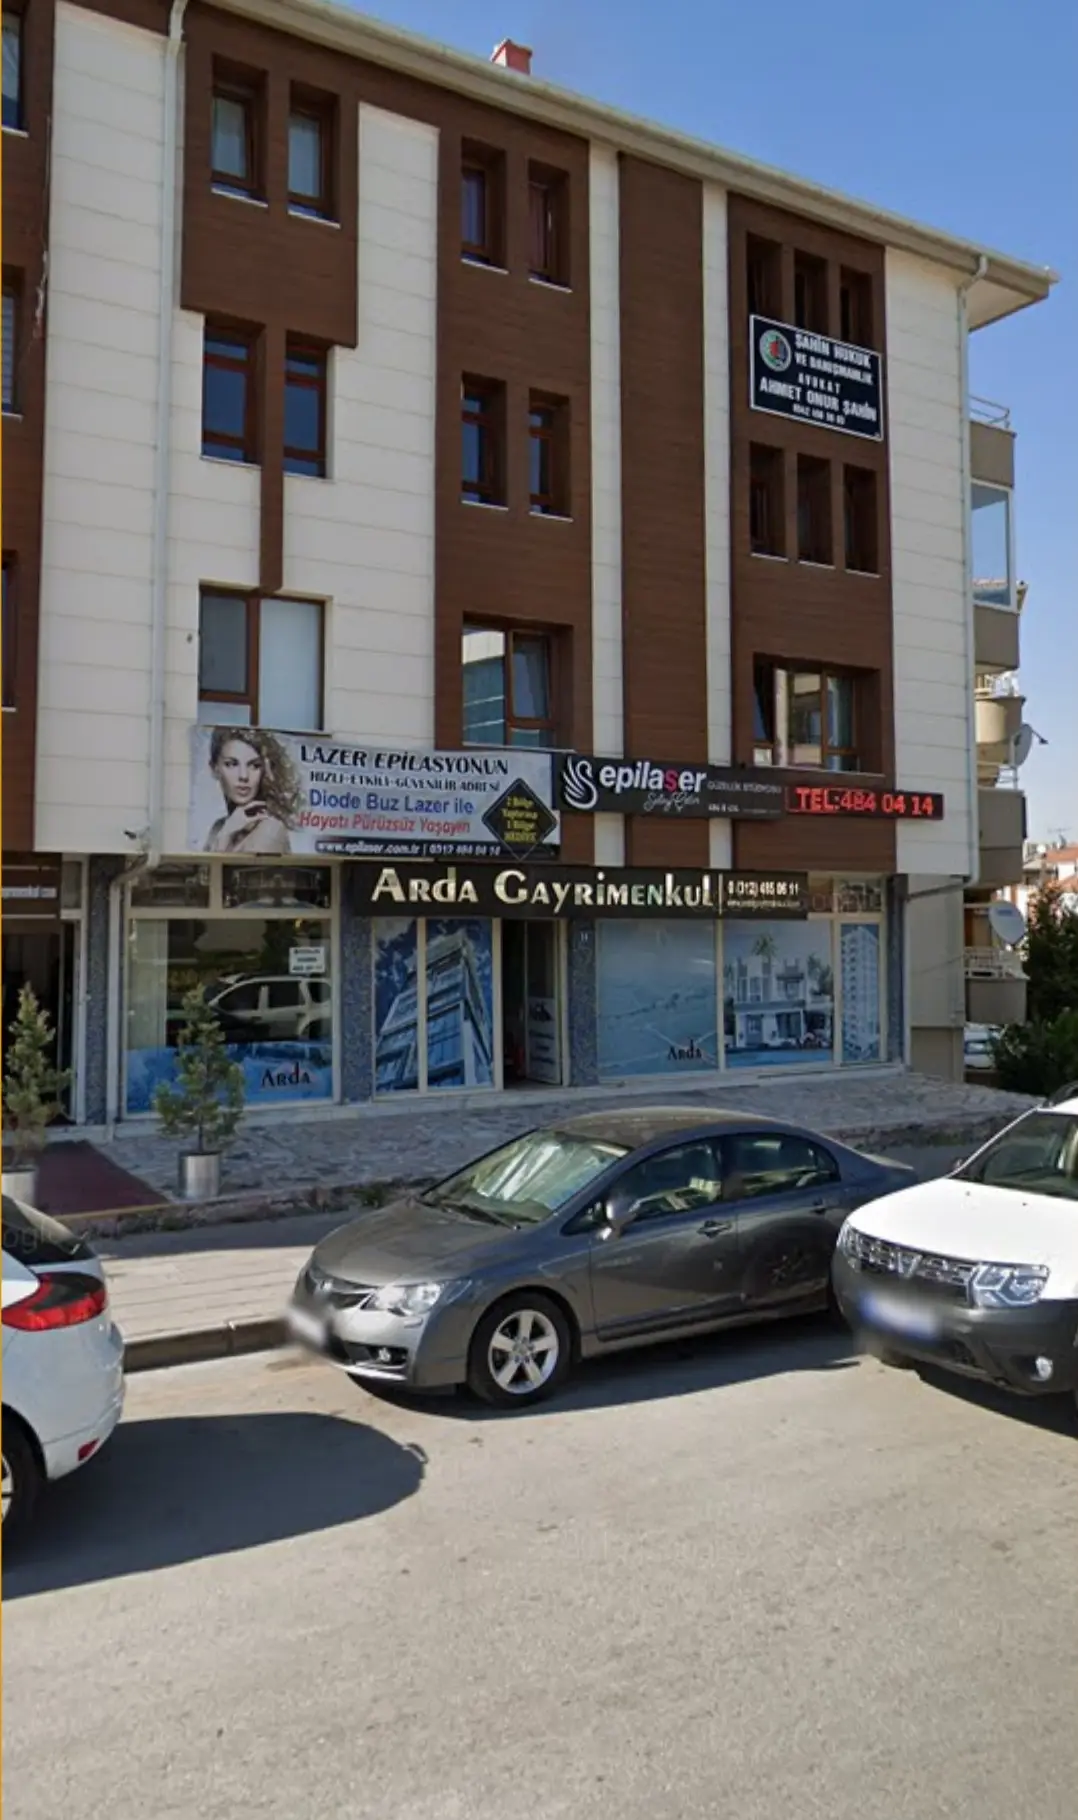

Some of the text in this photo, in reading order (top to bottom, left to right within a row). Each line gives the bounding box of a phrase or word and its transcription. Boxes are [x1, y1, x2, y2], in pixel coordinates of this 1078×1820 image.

[795, 352, 807, 367] VE
[760, 376, 801, 401] AHMET
[806, 389, 839, 411] ONUR
[301, 745, 509, 775] LAZER EPİLASYONUN
[600, 761, 707, 794] epilaser
[309, 789, 474, 814] Diode Buz Lazer ile
[883, 794, 906, 813] 04
[911, 796, 934, 815] 14
[300, 811, 348, 831] Hayatı
[352, 813, 415, 832] Pürüzsüz
[261, 1062, 312, 1088] Arda
